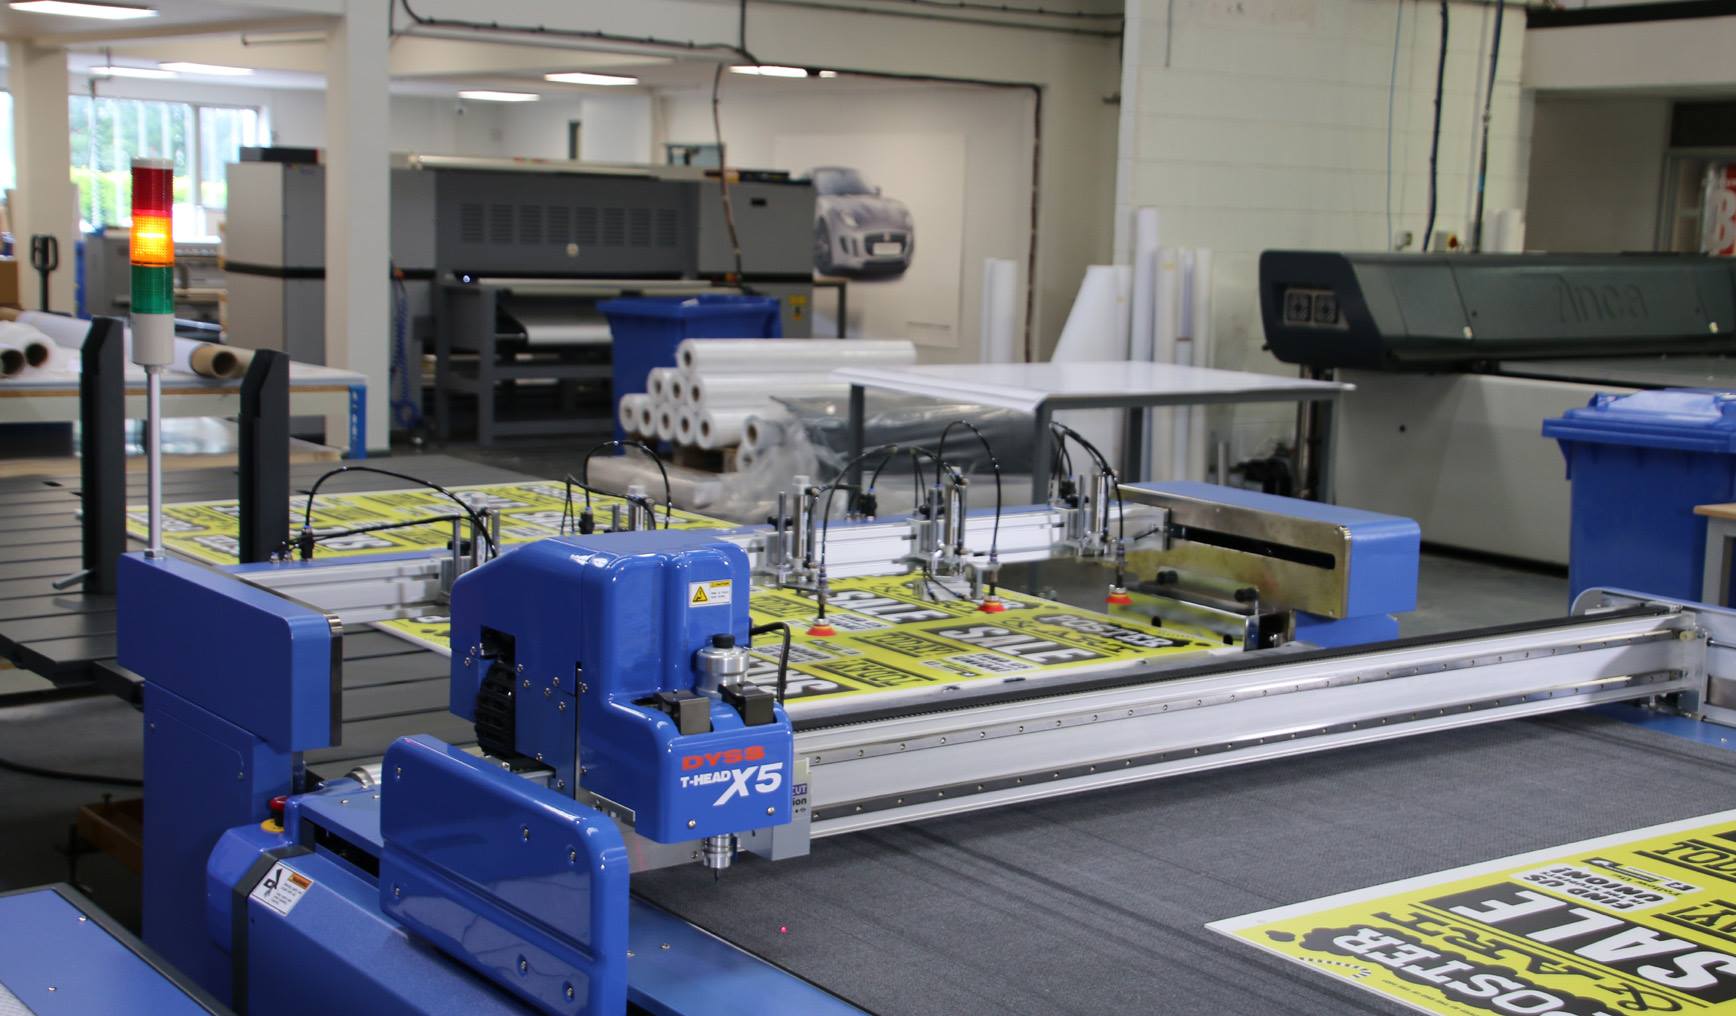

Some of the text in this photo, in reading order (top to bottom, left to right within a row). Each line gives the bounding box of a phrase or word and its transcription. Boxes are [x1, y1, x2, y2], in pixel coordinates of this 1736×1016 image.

[938, 625, 1097, 664] SALE
[1038, 615, 1174, 648] POSTER
[682, 746, 766, 771] DYSS
[680, 762, 784, 807] T-HEAD X5
[1523, 872, 1635, 910] FIND US
[1551, 867, 1664, 902] UNION!
[1371, 911, 1604, 980] ART
[1449, 889, 1736, 990] SALE
